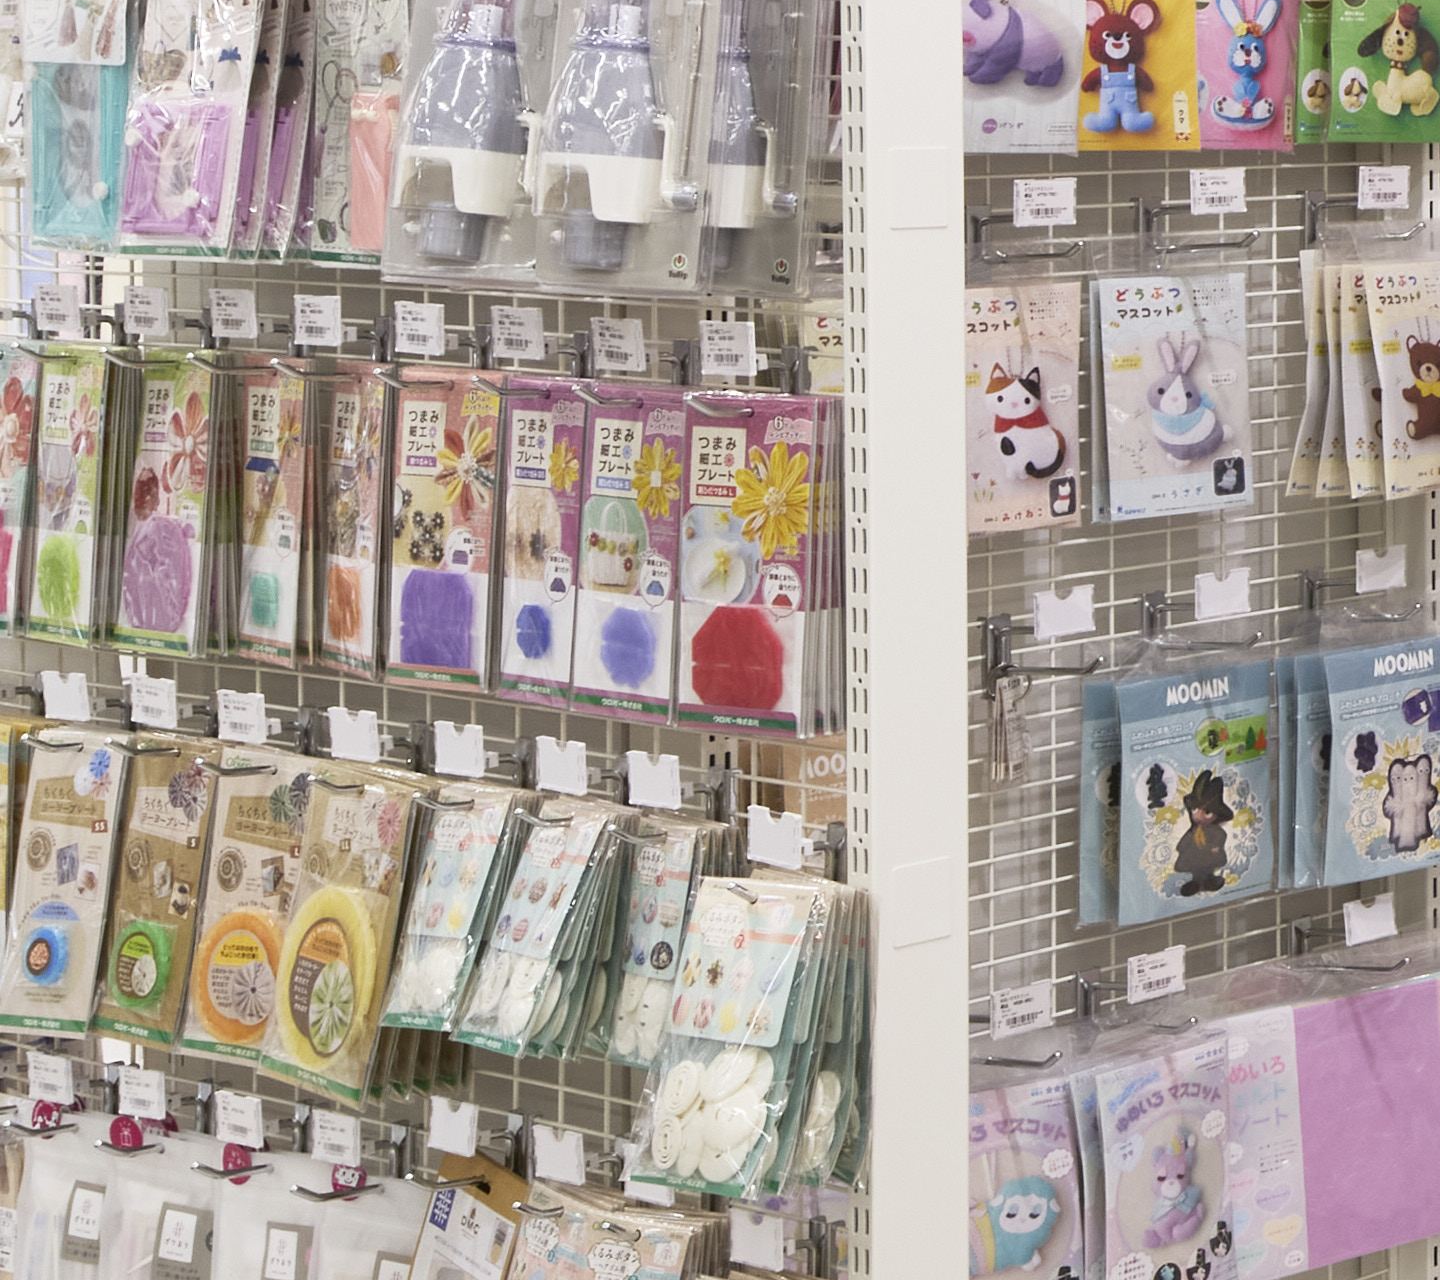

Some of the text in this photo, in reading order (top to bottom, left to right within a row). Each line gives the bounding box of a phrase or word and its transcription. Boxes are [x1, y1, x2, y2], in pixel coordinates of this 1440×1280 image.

[1115, 286, 1181, 303] どうぶつ
[1117, 305, 1174, 319] マスコット
[698, 435, 737, 451] つまみ
[698, 453, 722, 467] 細工
[696, 468, 735, 484] プレート
[1373, 649, 1434, 677] MOOMIN
[1166, 676, 1229, 707] MOOMIN
